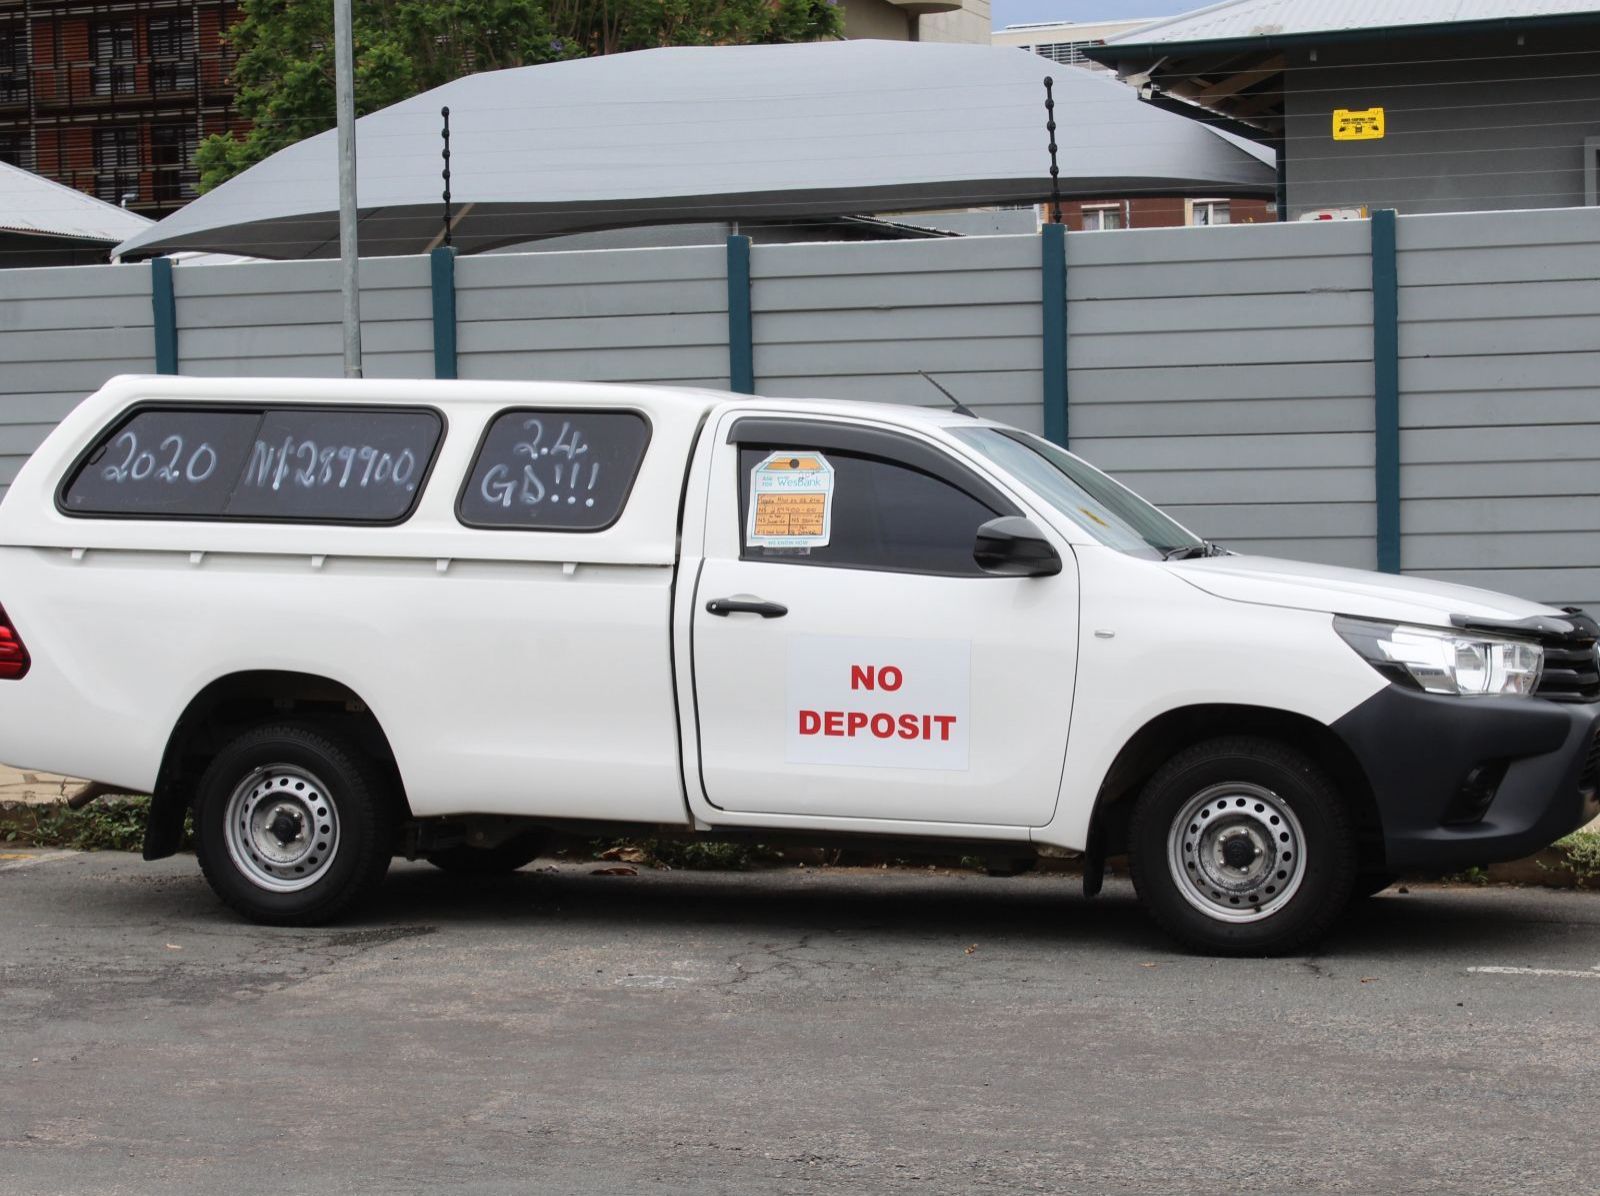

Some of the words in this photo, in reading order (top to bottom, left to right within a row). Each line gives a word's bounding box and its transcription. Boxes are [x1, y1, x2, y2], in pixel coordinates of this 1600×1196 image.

[104, 431, 217, 482] 2020
[851, 665, 903, 691] NO
[799, 710, 957, 741] DEPOSIT
